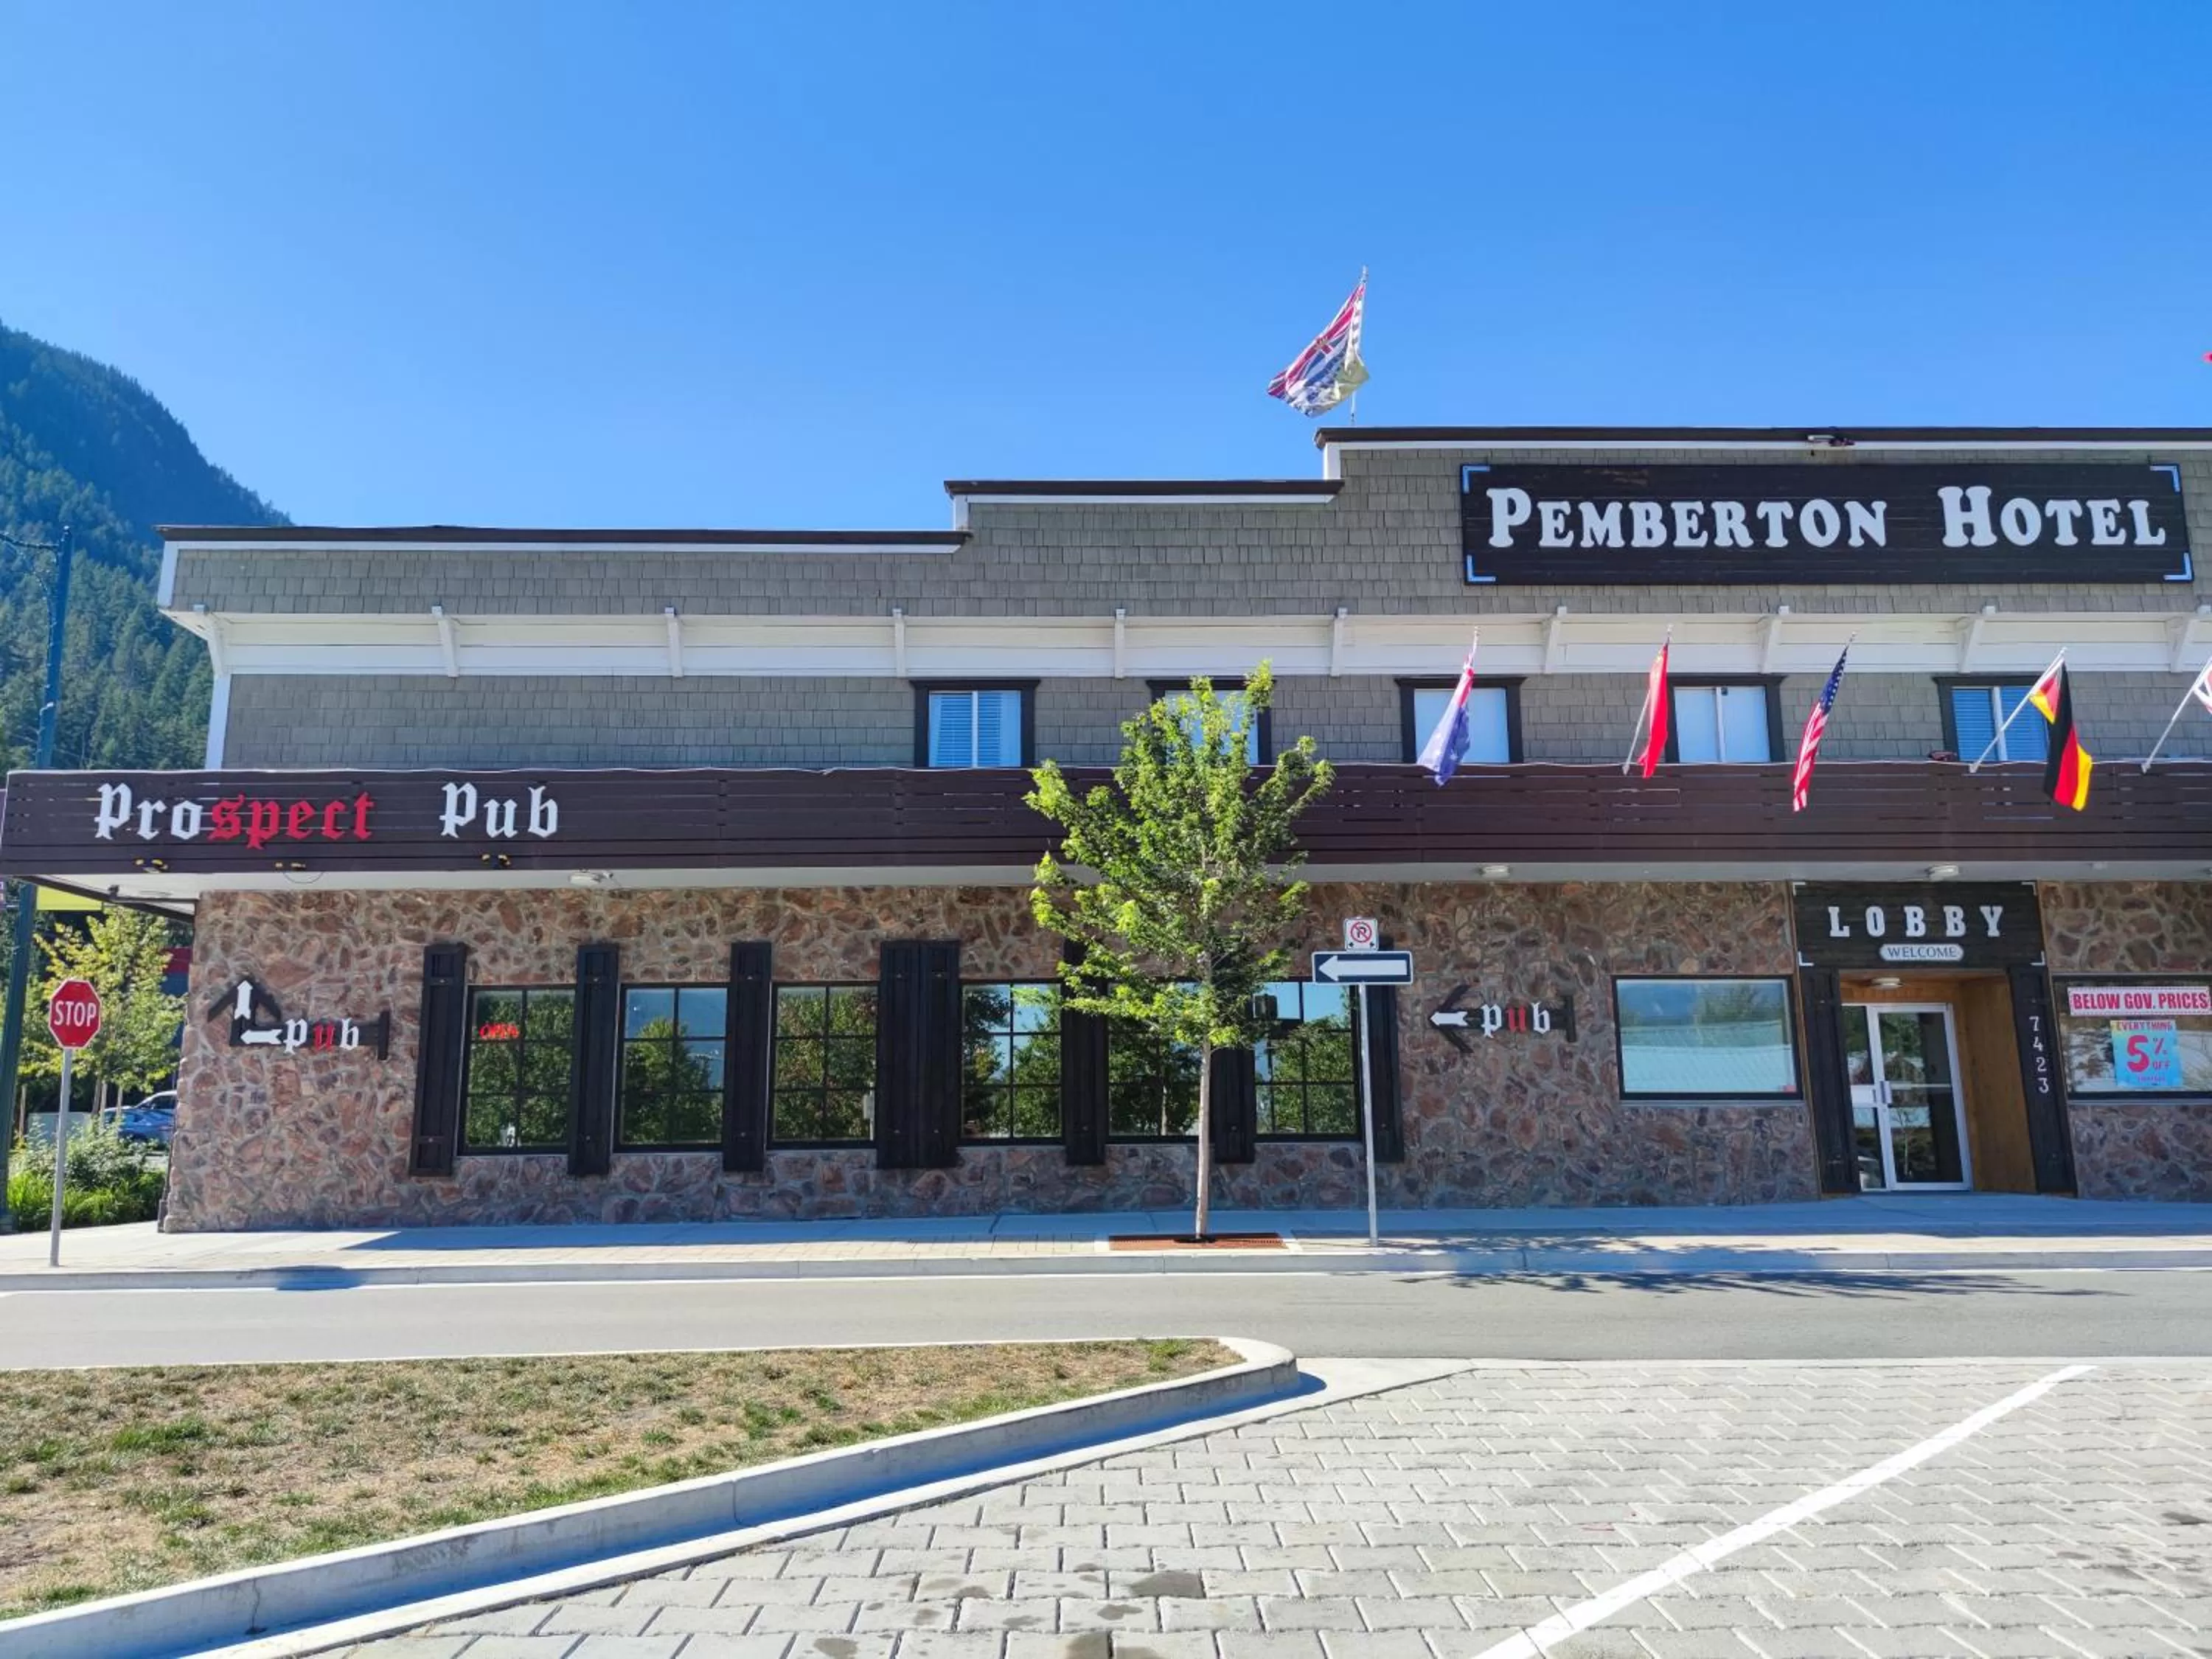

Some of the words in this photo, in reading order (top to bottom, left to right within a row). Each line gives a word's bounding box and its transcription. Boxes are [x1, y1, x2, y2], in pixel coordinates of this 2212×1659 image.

[1486, 487, 1888, 549] PEMBERTON
[1939, 485, 2166, 549] HOTEL
[94, 782, 374, 849] Prospect
[440, 782, 560, 838] Pub
[1828, 905, 2003, 937] LOBBY
[1887, 946, 1958, 958] WELCOME
[54, 1001, 97, 1026] STOP
[2073, 993, 2120, 1009] BELOW
[2124, 992, 2155, 1009] GOV.
[2158, 992, 2208, 1009] PRICES
[282, 1018, 360, 1054] pub
[479, 1023, 520, 1039] OPEN
[1482, 1003, 1551, 1037] pub
